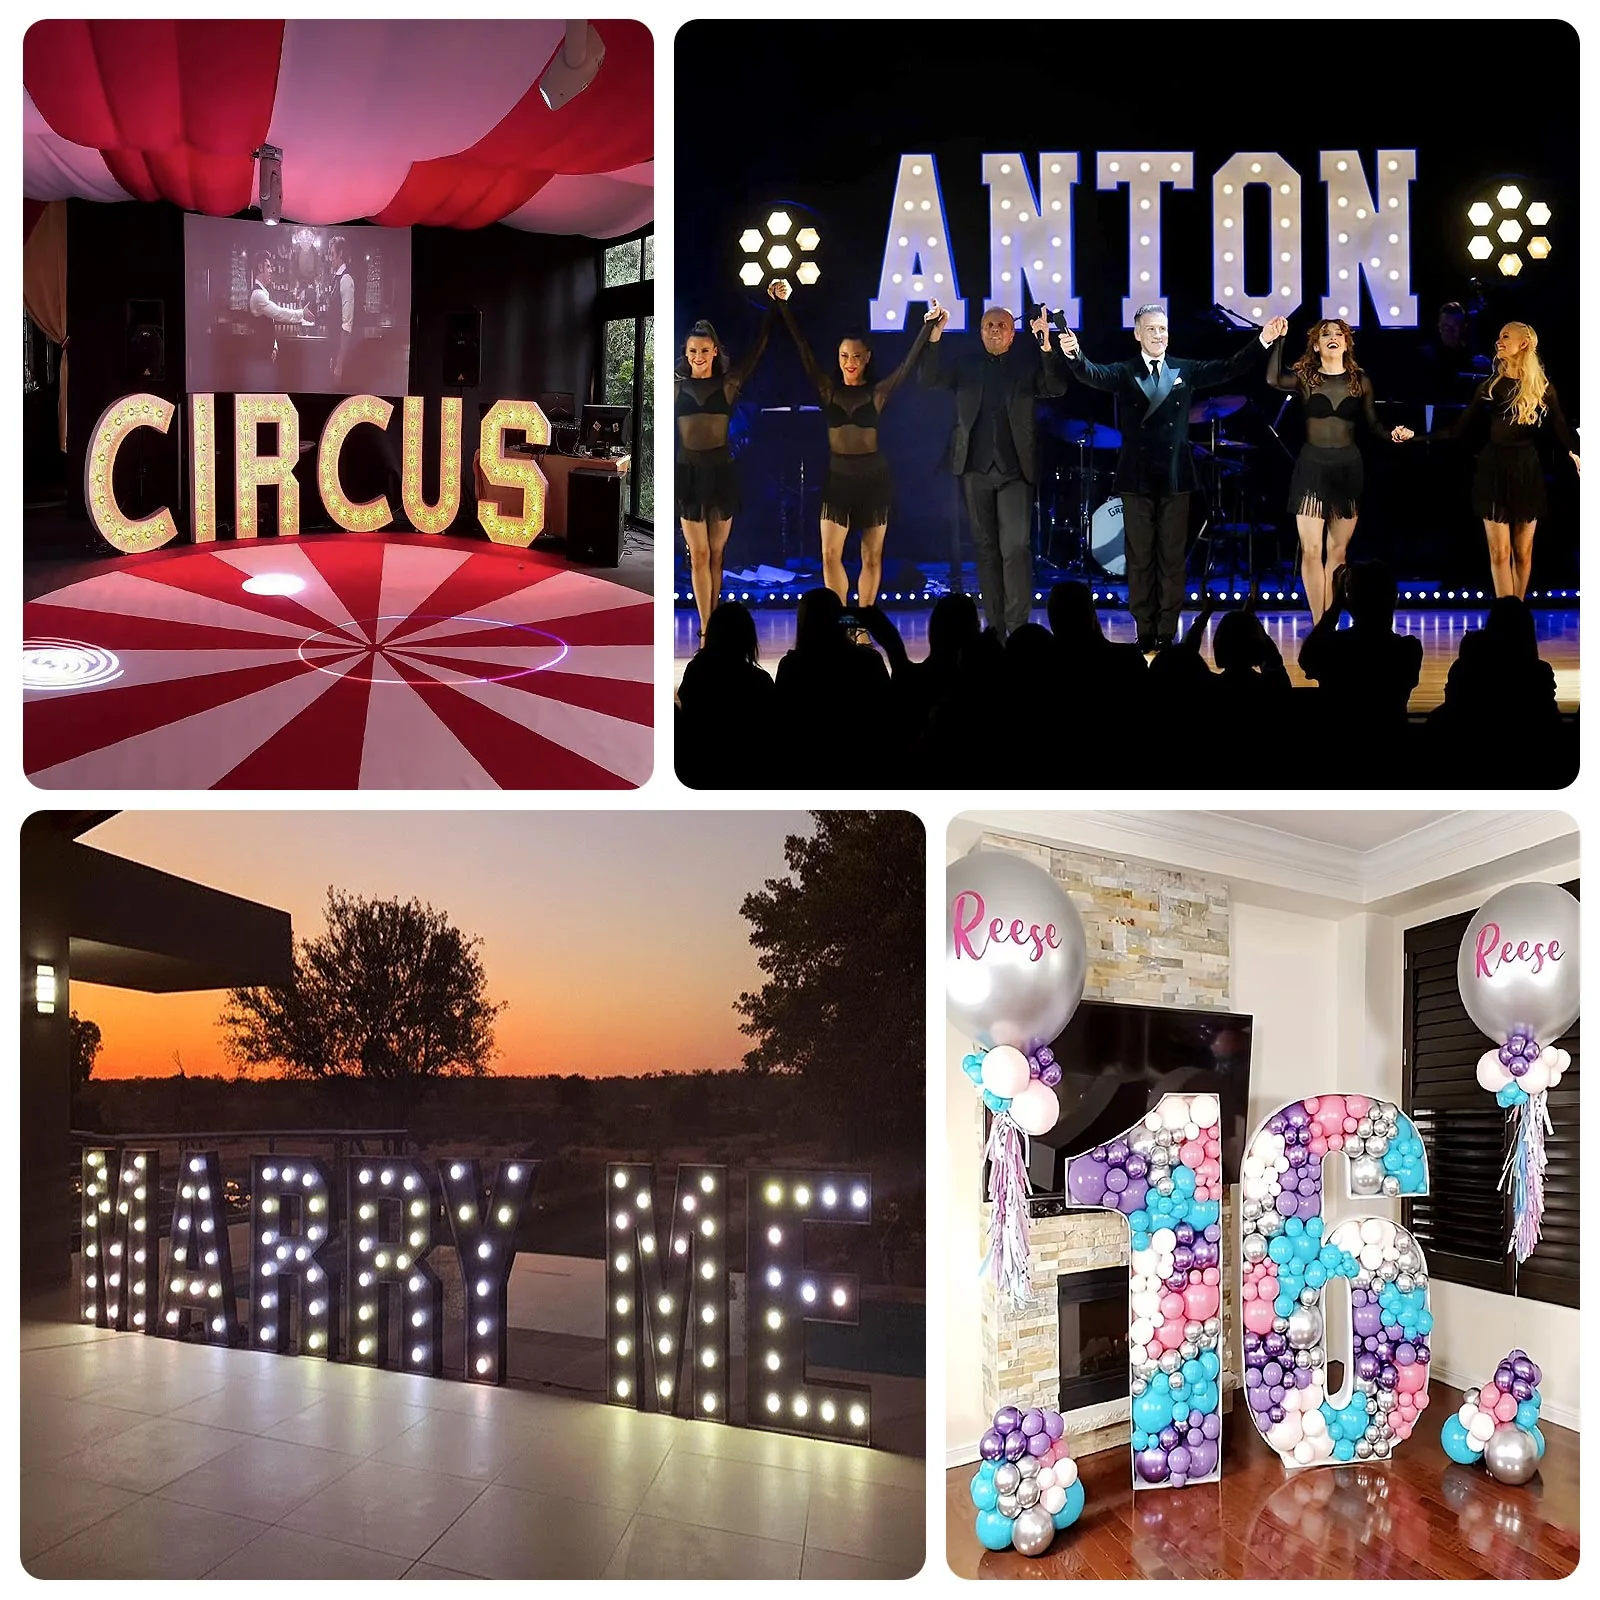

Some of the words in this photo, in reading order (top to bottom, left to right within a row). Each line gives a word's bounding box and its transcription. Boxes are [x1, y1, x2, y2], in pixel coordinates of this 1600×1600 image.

[870, 149, 1418, 331] ANTON
[84, 393, 552, 553] CIRCUS
[951, 890, 1063, 962] Reese
[1475, 922, 1565, 979] Reese
[80, 1147, 541, 1385] MARRY
[605, 1163, 872, 1447] ME
[1065, 1093, 1434, 1490] 16
